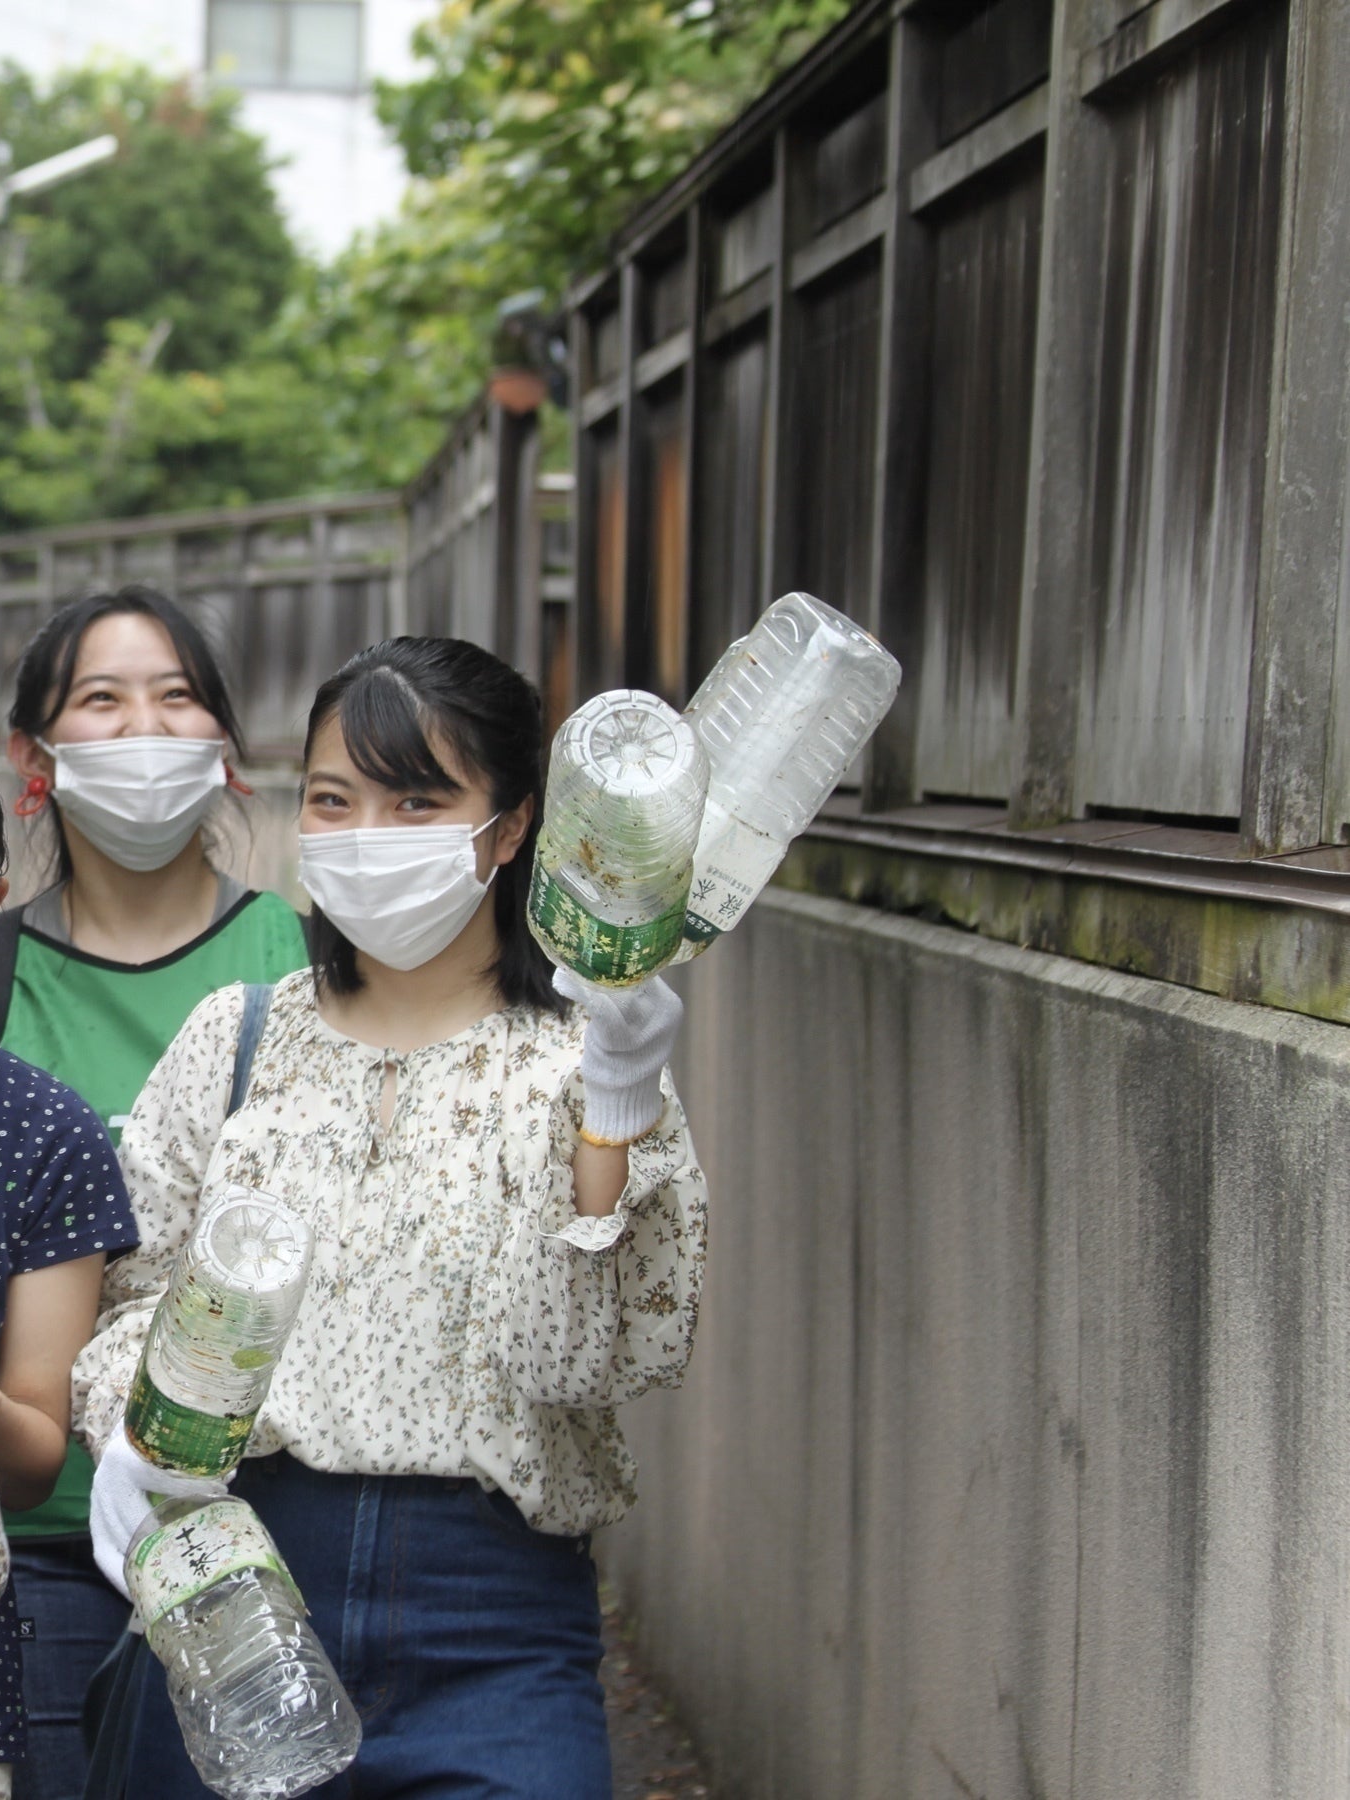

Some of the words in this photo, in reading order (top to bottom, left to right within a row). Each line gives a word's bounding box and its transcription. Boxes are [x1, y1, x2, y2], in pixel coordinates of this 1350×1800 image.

[692, 878, 744, 919] 緑茶
[175, 1526, 227, 1578] 十六茶
